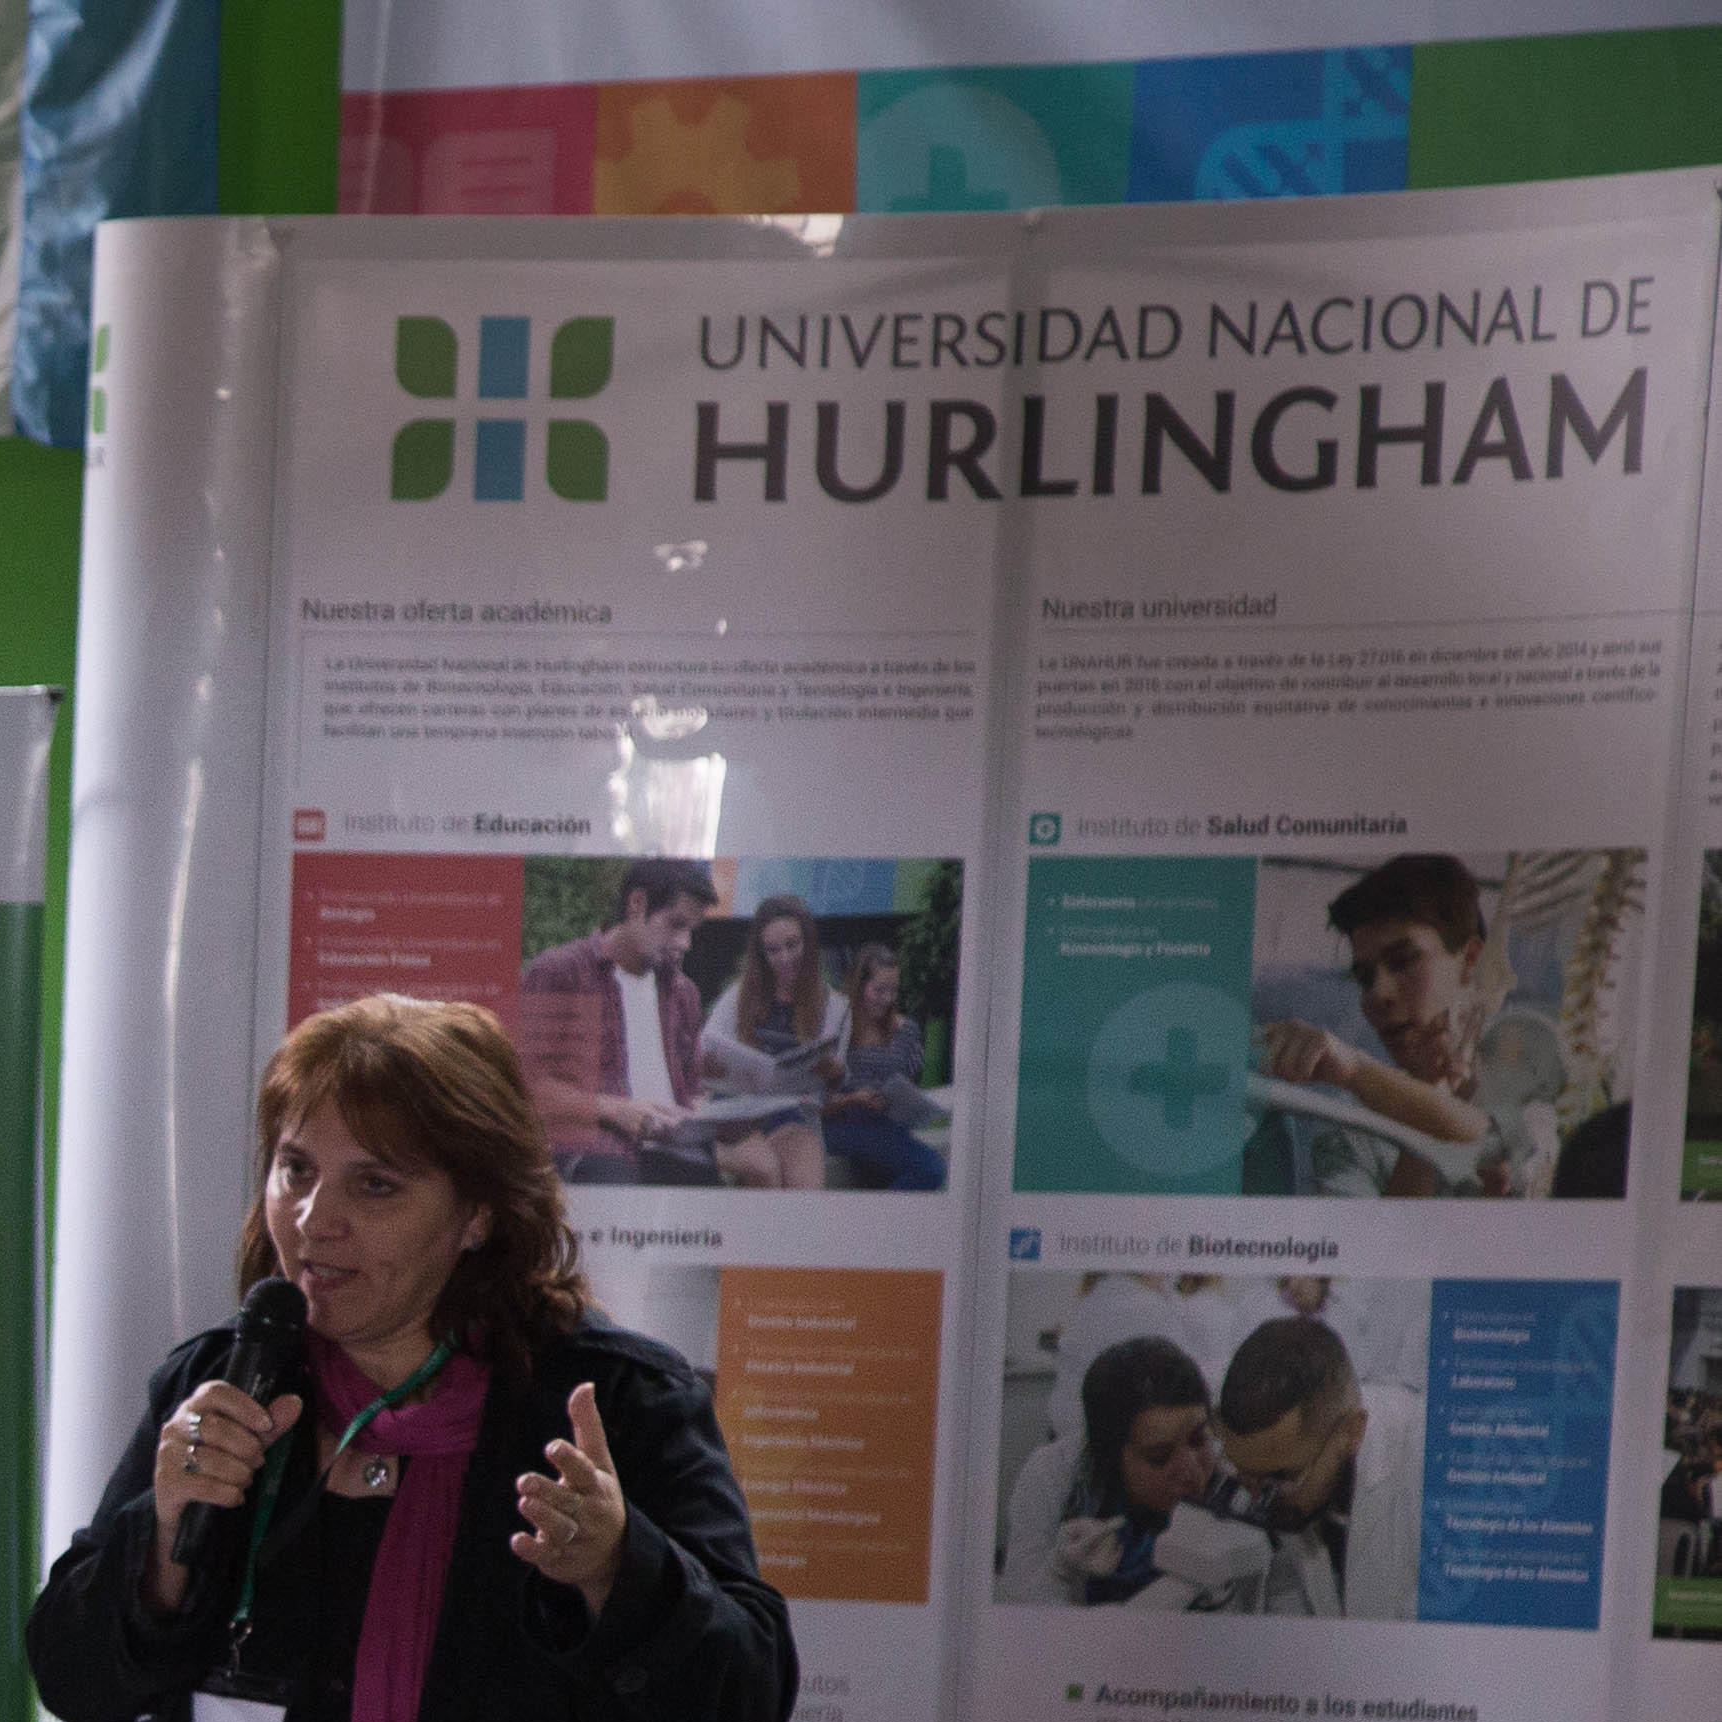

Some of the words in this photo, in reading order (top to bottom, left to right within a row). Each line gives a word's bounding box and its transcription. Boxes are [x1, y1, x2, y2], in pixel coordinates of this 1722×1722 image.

[699, 305, 1182, 371] UNIVERSIDAD
[1208, 287, 1555, 357] NACIONAL
[1582, 278, 1653, 337] DE
[693, 368, 1648, 504] HURLINGHAM
[301, 599, 394, 622] Nuestra
[402, 598, 473, 623] oferta
[480, 598, 612, 624] académica
[1042, 597, 1134, 620] Nuestra
[1142, 593, 1277, 620] universidad
[473, 813, 591, 836] Educación
[1207, 813, 1270, 837] Salud
[1276, 812, 1408, 837] Comunitaria
[611, 1227, 724, 1251] Ingeniería
[1188, 1234, 1340, 1264] Biotecnología
[1095, 1684, 1300, 1713] Acompañamiento
[1324, 1695, 1356, 1716] los
